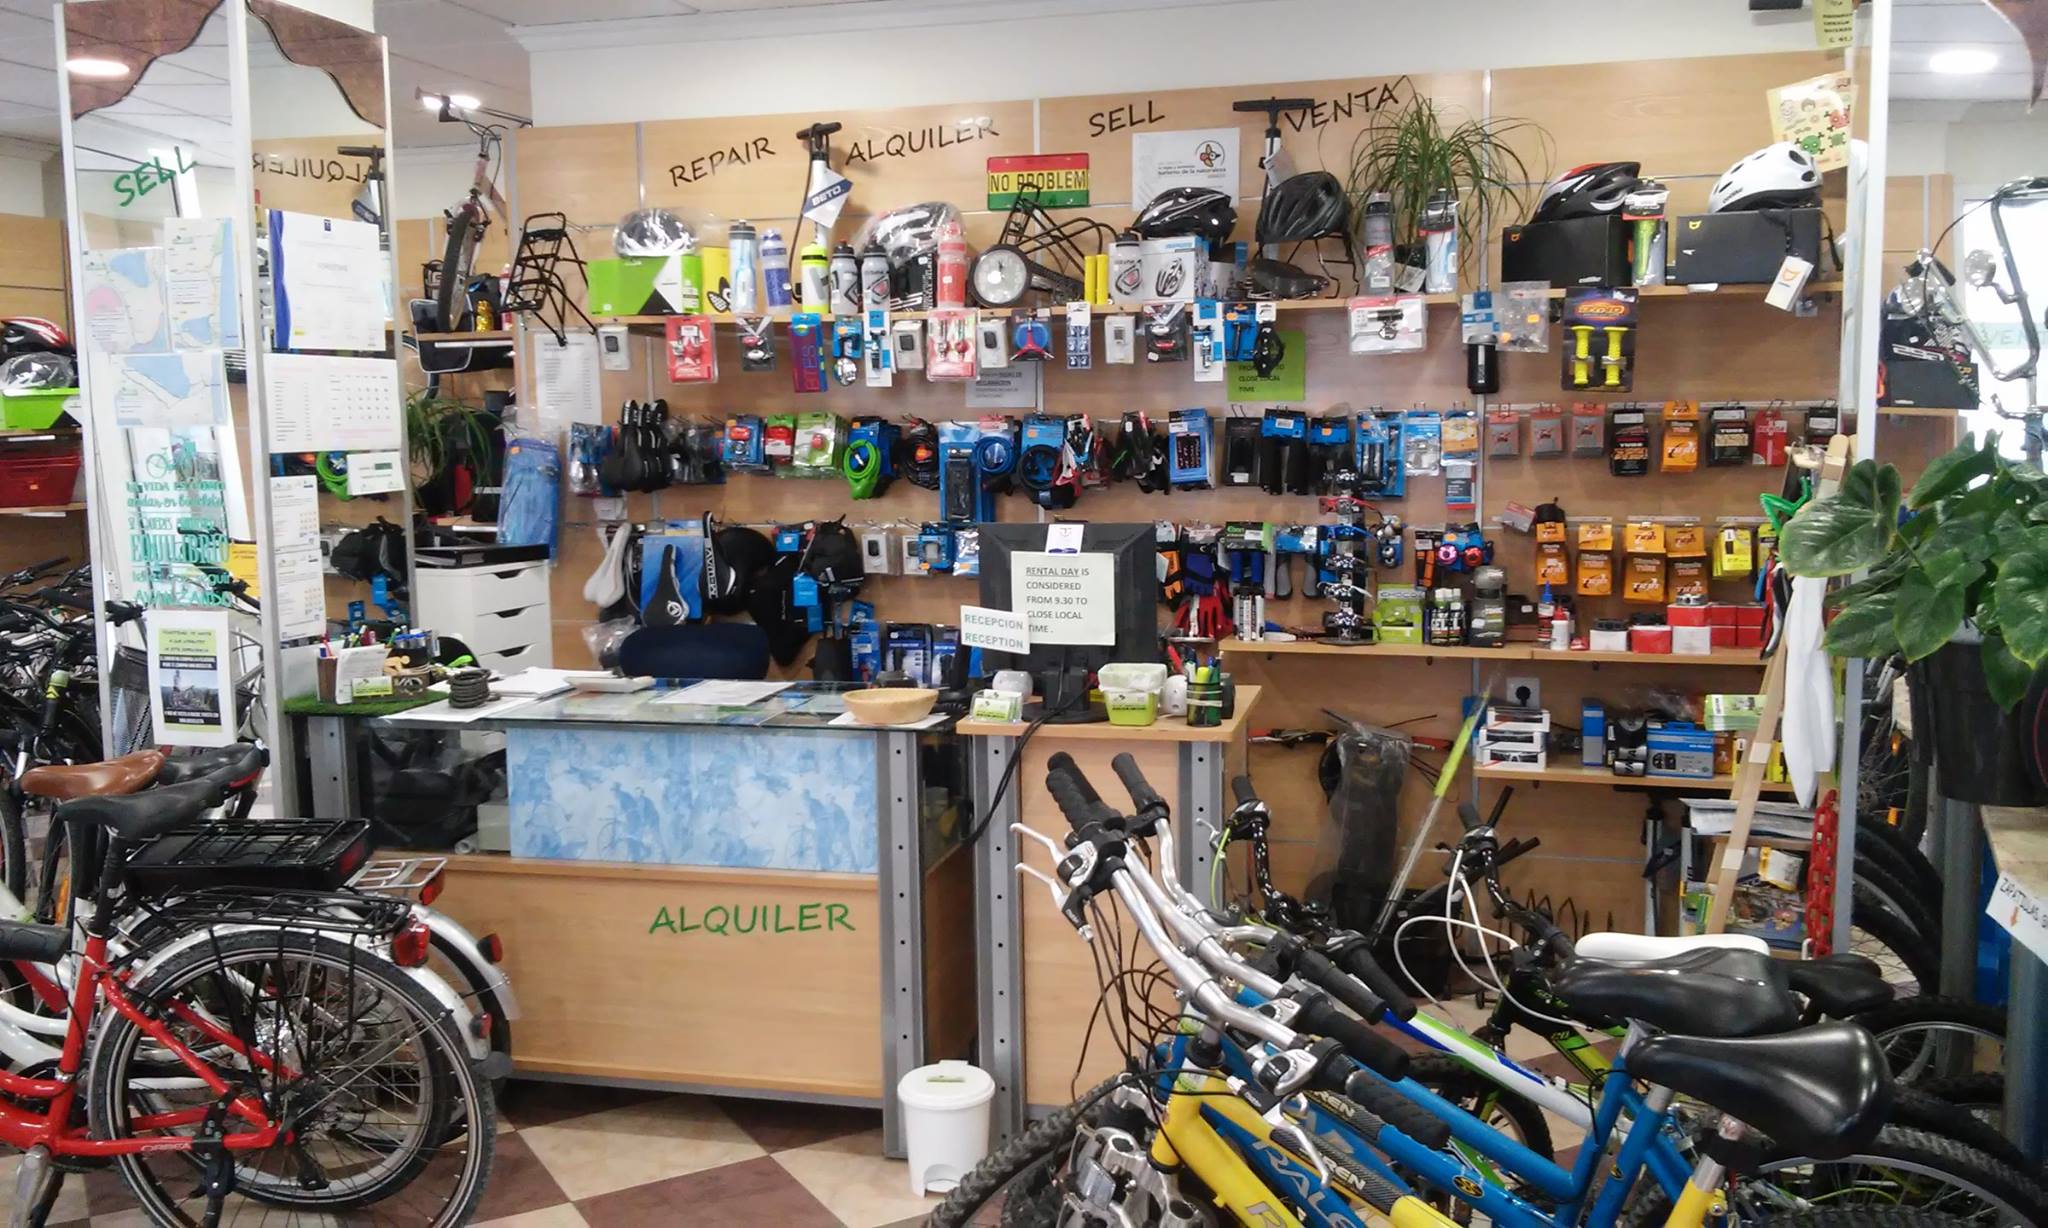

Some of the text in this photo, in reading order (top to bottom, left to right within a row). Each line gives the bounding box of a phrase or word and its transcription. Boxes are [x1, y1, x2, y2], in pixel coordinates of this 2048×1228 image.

[1088, 99, 1166, 138] SELL
[1283, 82, 1400, 133] VENTA
[844, 115, 1000, 167] ALQUILER
[668, 136, 777, 188] REPAIR
[113, 145, 198, 208] SELL
[990, 170, 1087, 192] NO PROBLEM
[811, 184, 843, 207] BETO
[1026, 567, 1090, 577] RENTAL DAY IS
[1026, 581, 1082, 591] CONSIDERED
[1026, 596, 1088, 606] FROM 9.30 TO
[964, 613, 1024, 631] RECEPCION
[1027, 611, 1083, 620] CLOSE LOCAL
[964, 632, 1024, 650] RECEPTION
[648, 903, 857, 936] ALQUILER
